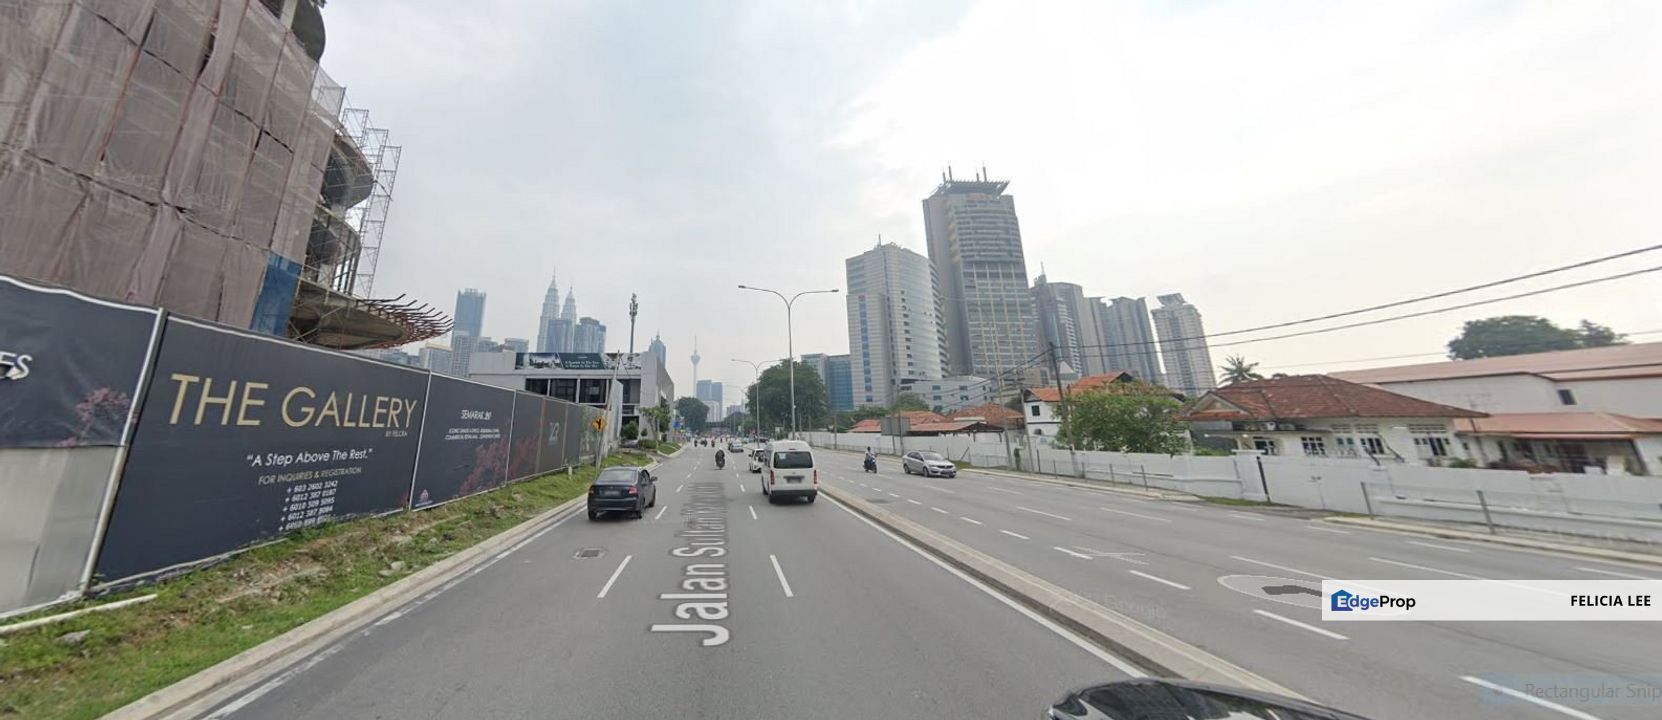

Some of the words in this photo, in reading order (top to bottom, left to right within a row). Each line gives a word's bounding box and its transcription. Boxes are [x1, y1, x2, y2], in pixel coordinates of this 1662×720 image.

[169, 373, 269, 426] THE
[281, 386, 417, 428] GALLERY
[265, 453, 293, 467] Step
[295, 451, 330, 464] Above
[332, 450, 348, 461] The
[258, 475, 276, 485] FOR
[277, 471, 313, 483] INQUIRIES
[314, 471, 320, 479] &
[321, 467, 362, 477] REGISTRATION
